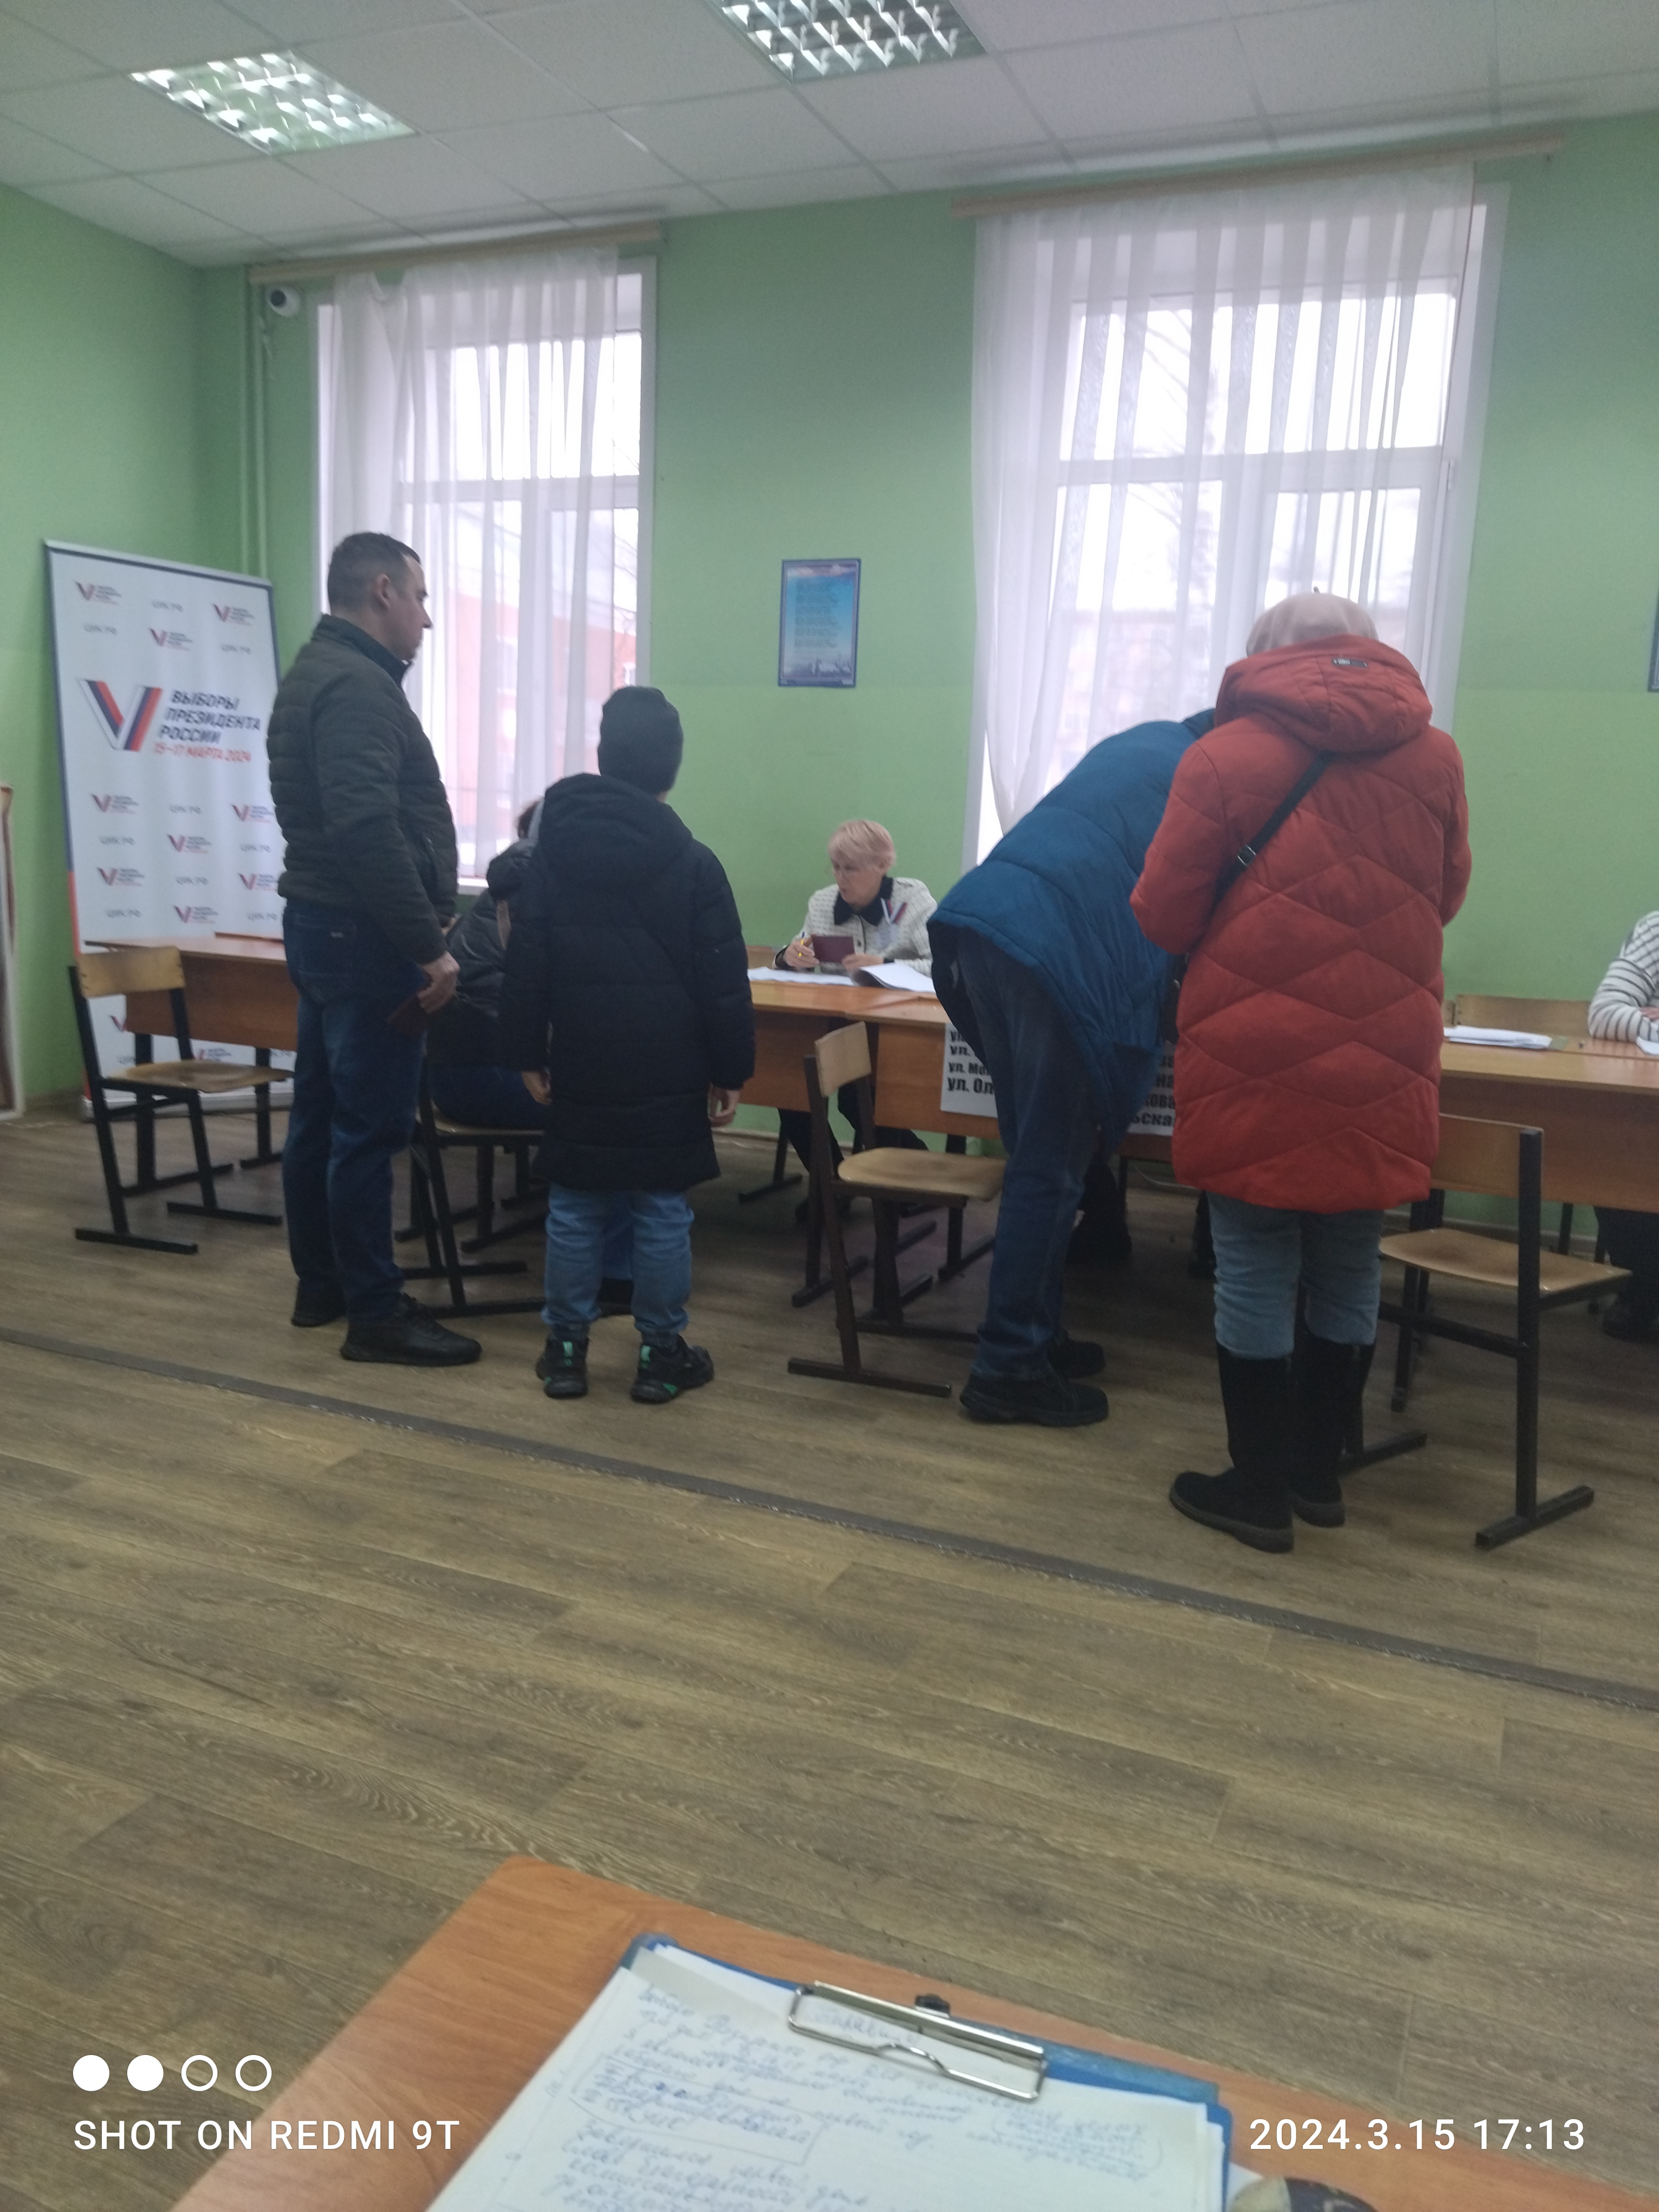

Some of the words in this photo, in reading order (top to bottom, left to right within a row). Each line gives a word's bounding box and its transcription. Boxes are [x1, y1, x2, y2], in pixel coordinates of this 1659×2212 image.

[171, 690, 239, 711] ВЫБОРЫ
[165, 707, 260, 731] ПРЕЗИДЕНТА
[158, 724, 221, 744] РОССИИ
[948, 1062, 966, 1073] ул.
[947, 1077, 969, 1092] ул.
